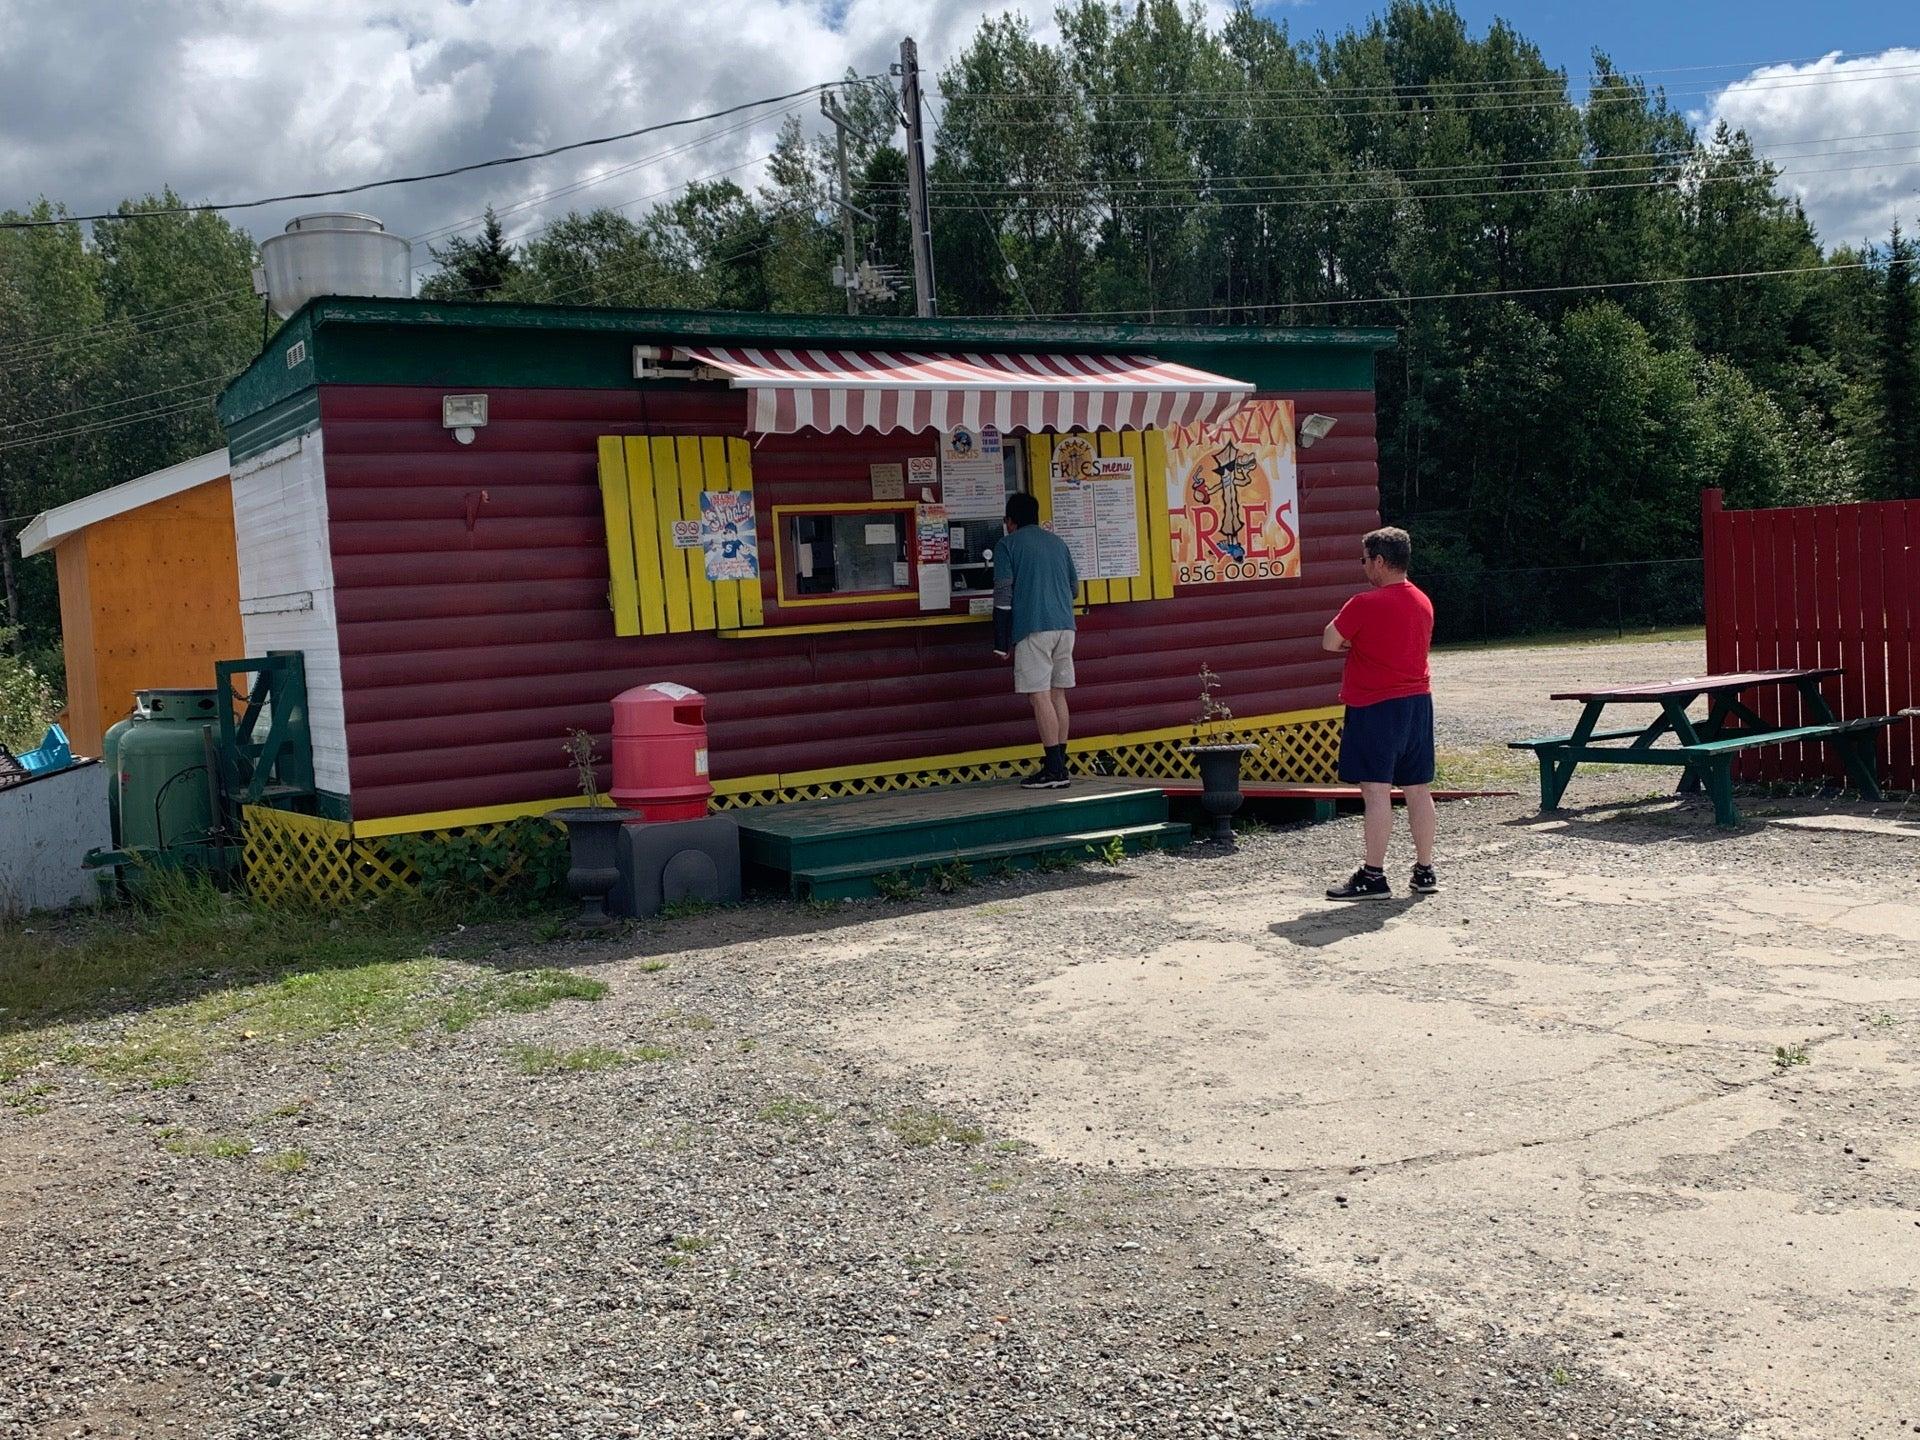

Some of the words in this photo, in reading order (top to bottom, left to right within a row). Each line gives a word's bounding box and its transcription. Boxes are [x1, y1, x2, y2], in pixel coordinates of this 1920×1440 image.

[1058, 439, 1092, 453] KRAZY
[1102, 461, 1132, 473] menu
[1179, 561, 1285, 583] 856-0050
